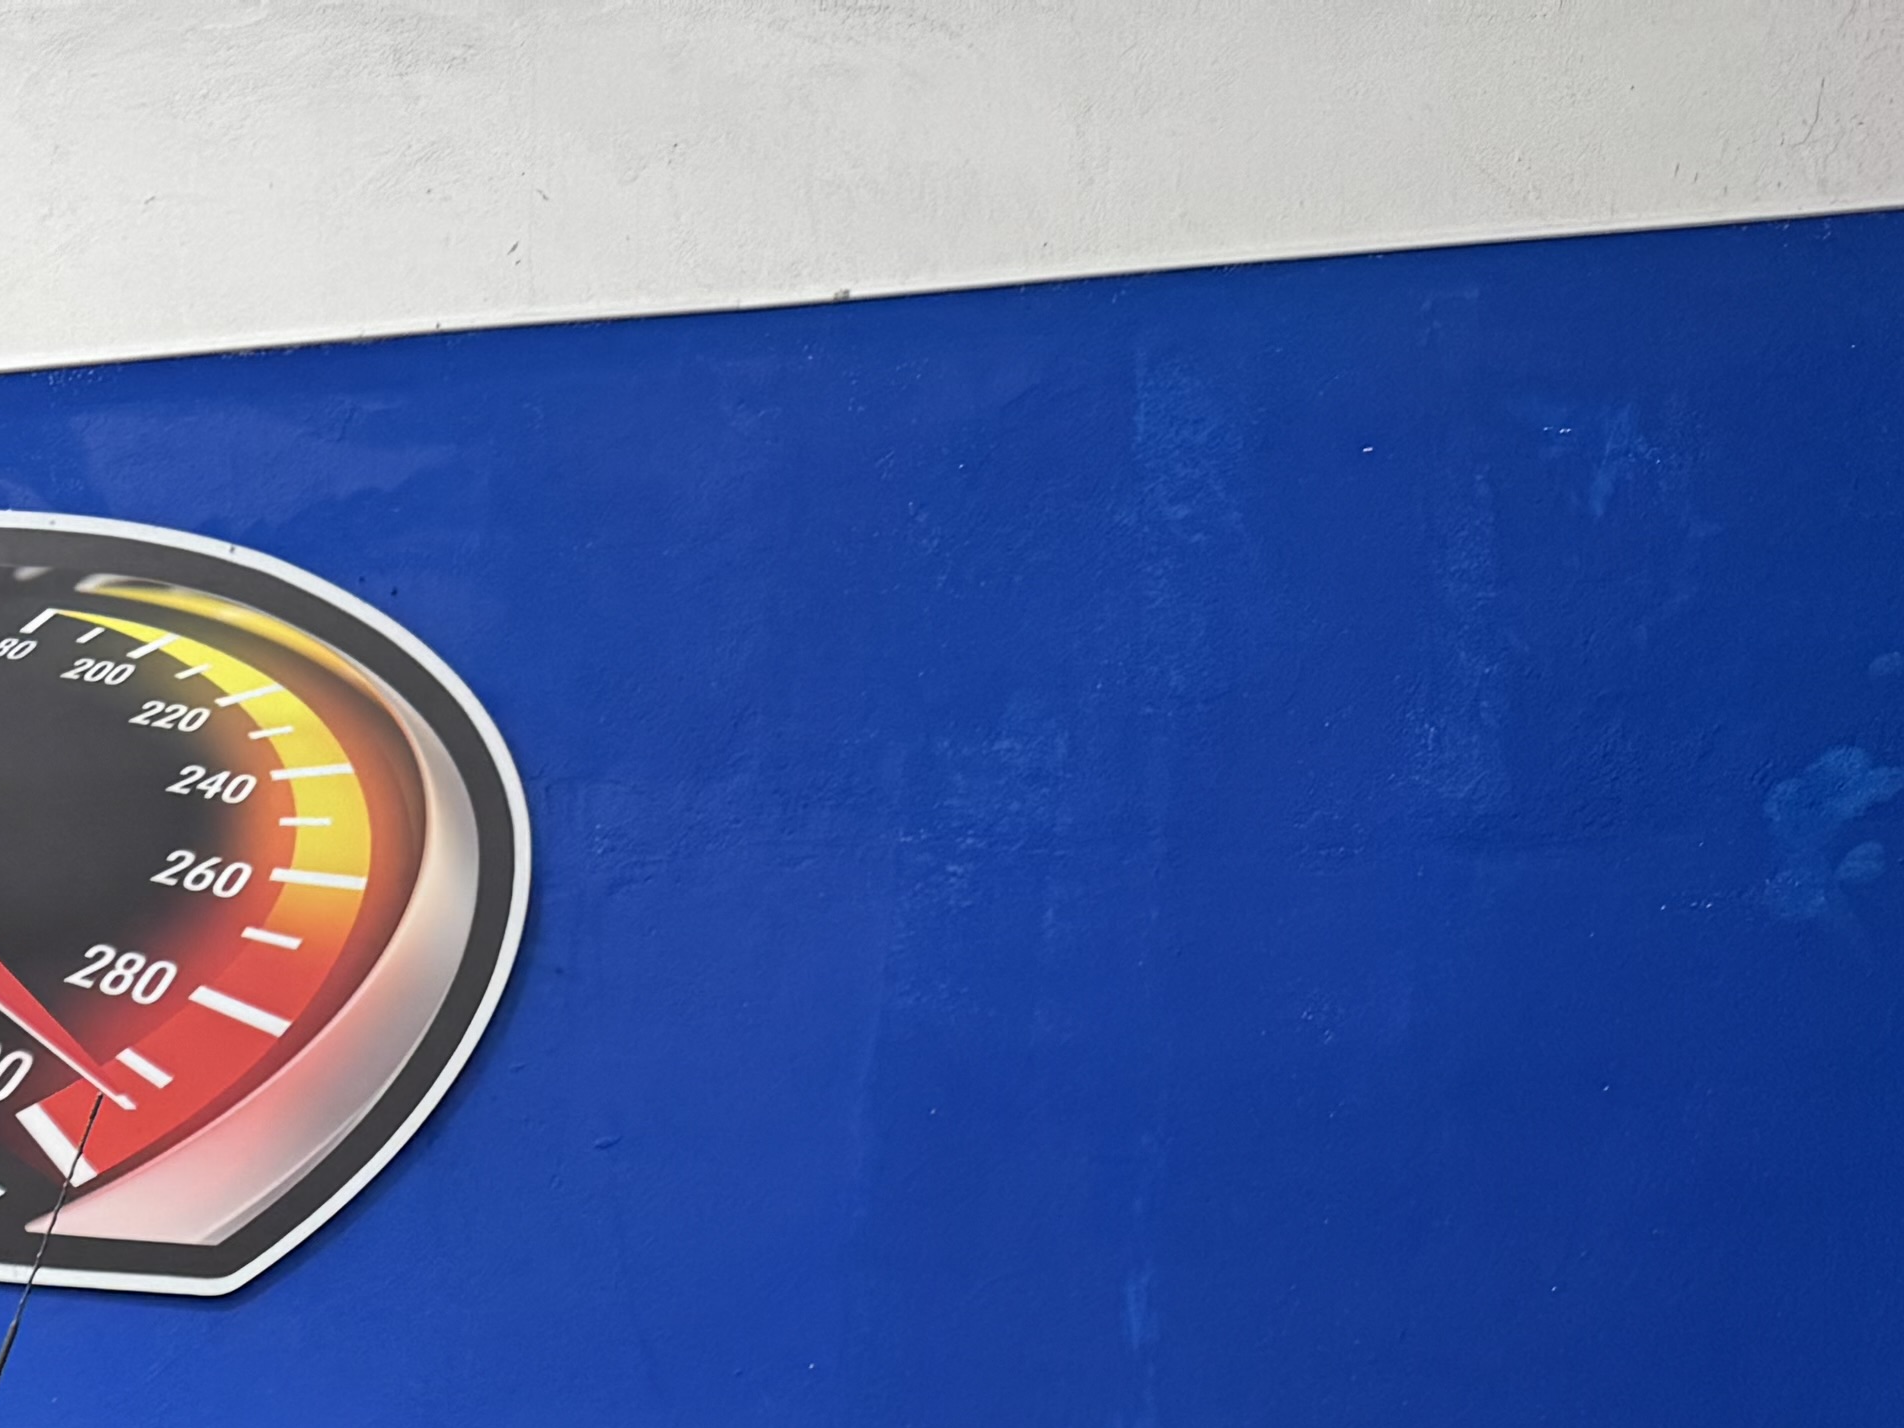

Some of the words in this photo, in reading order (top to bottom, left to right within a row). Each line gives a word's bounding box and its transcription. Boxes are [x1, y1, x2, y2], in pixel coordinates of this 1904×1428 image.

[59, 657, 136, 686] 200
[127, 699, 211, 733] 220
[164, 764, 258, 804] 240
[149, 848, 254, 899] 260
[63, 943, 179, 1006] 280
